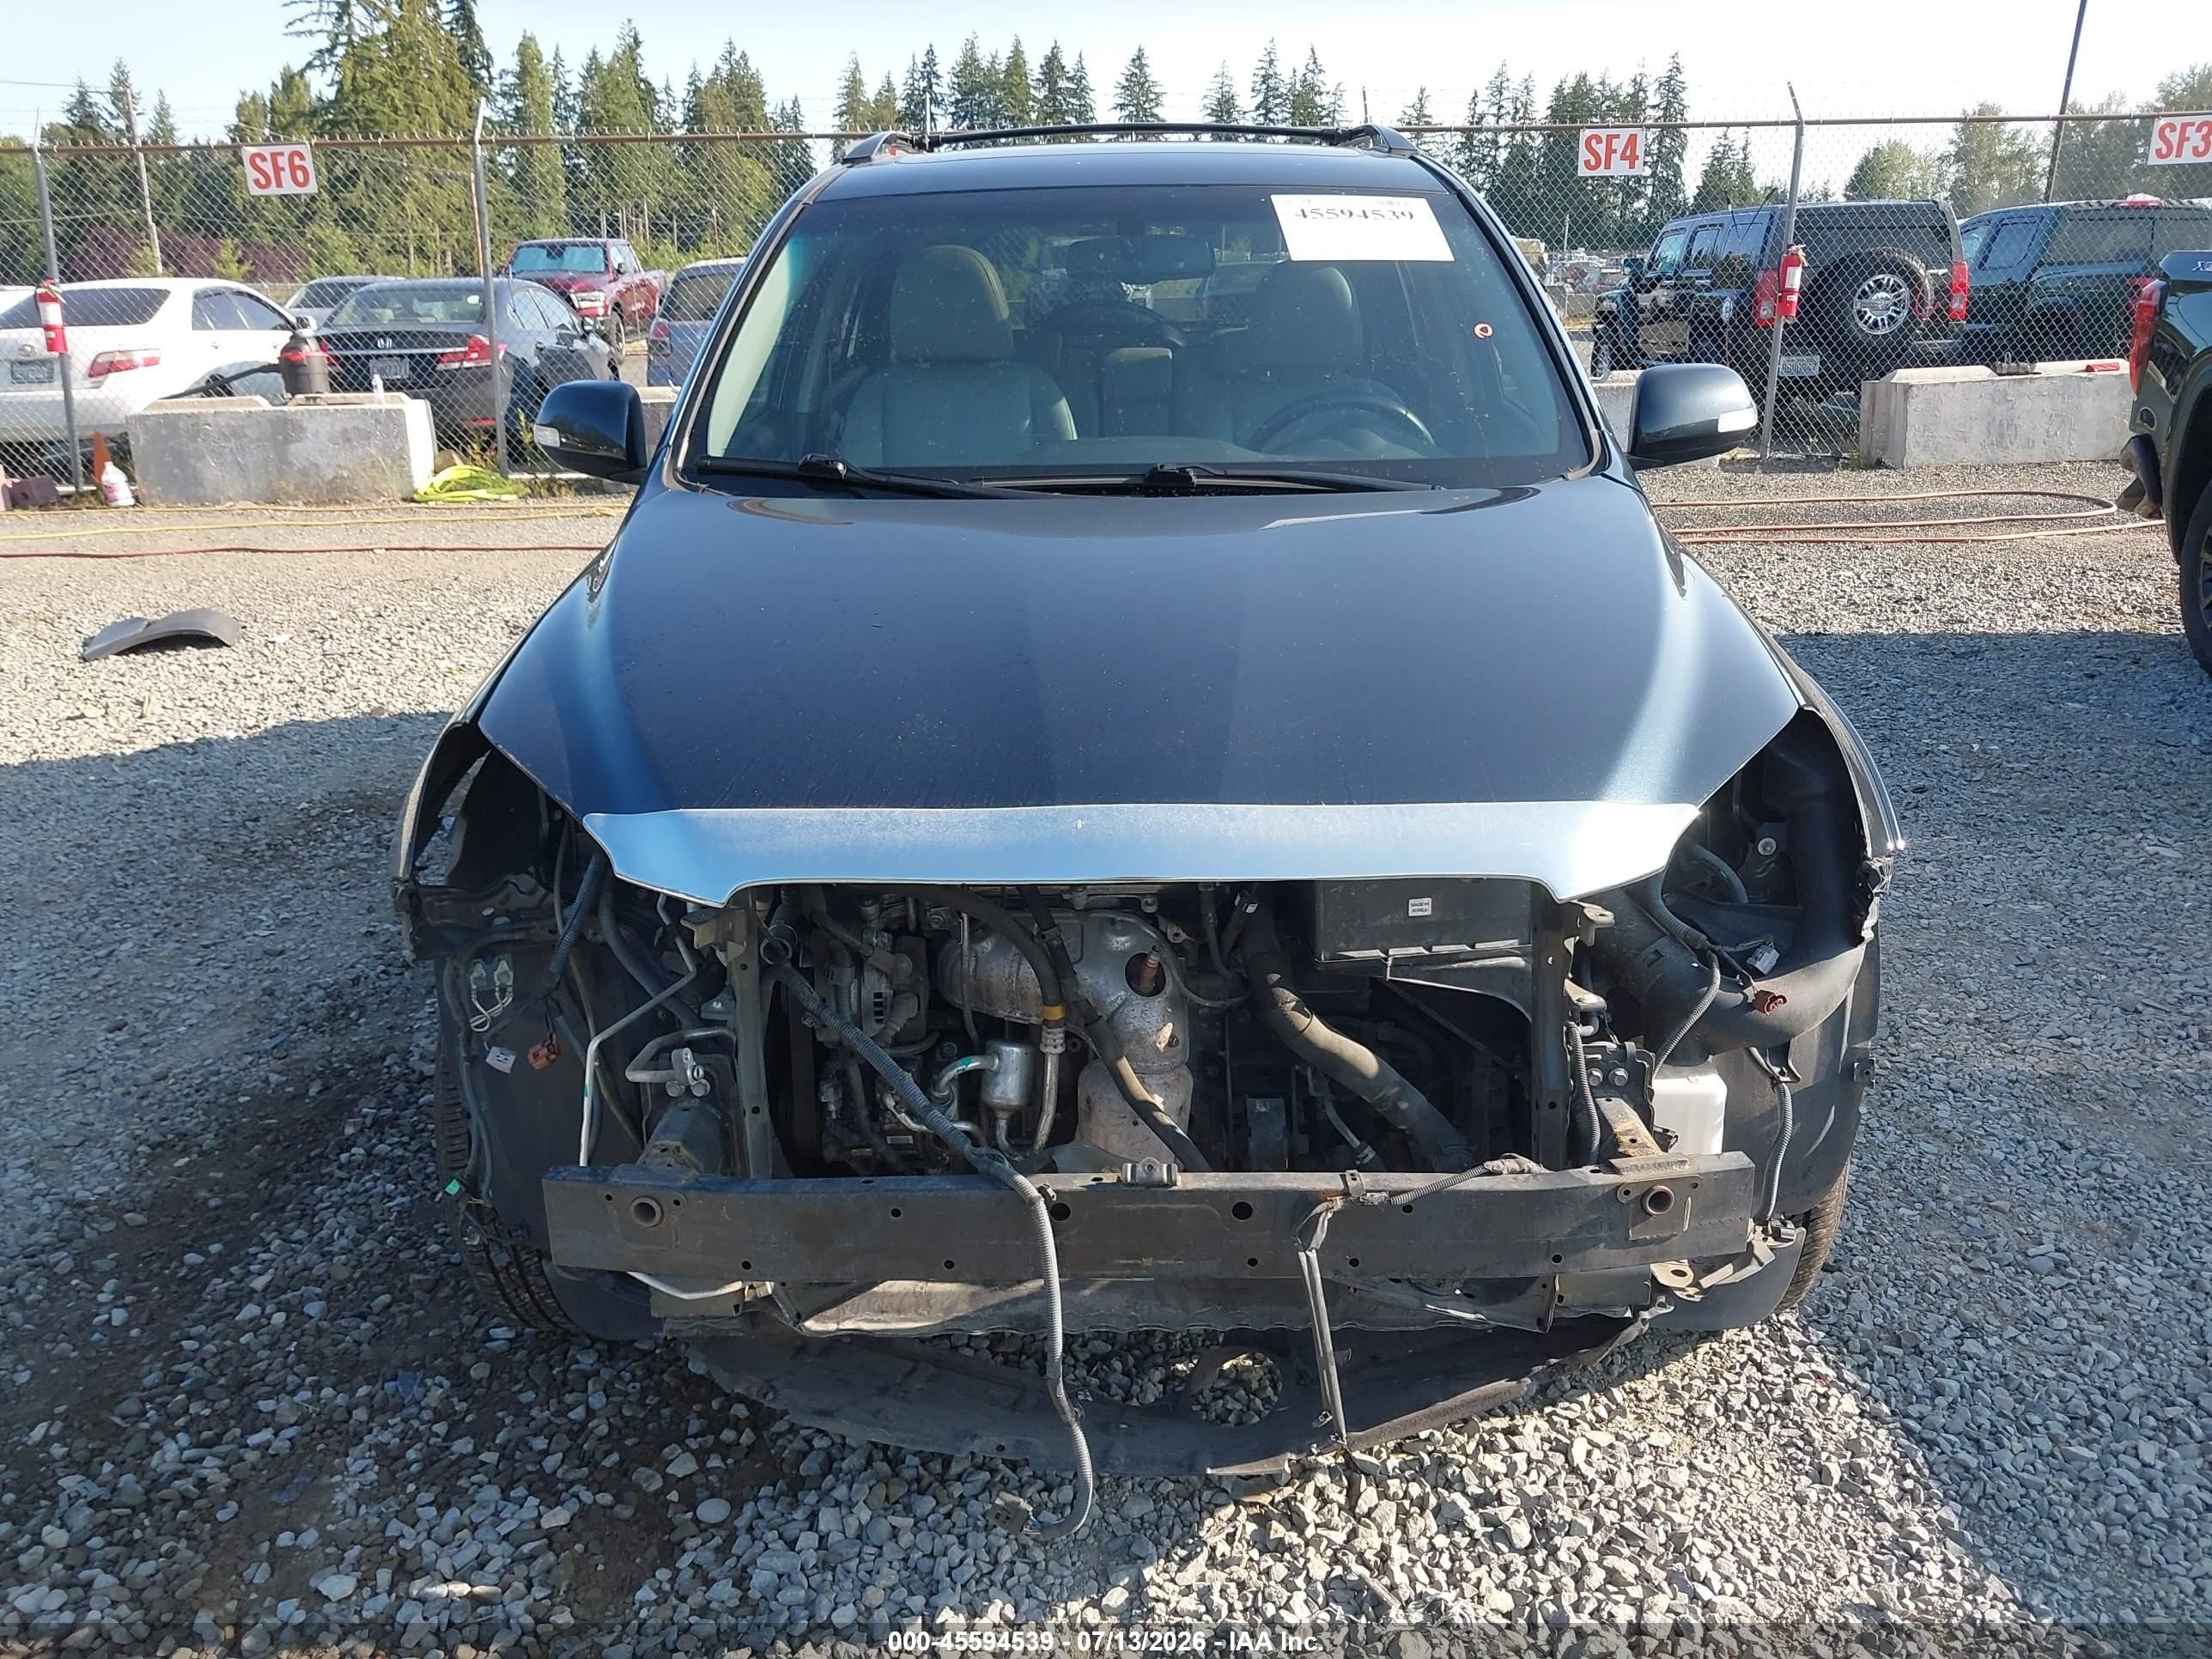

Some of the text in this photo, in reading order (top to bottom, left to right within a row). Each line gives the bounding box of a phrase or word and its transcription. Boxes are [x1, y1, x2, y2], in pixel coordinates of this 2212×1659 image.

[1583, 133, 1639, 171] SF4
[2155, 120, 2212, 160] SF3
[249, 150, 310, 190] SF6
[1295, 208, 1413, 221] 45594539
